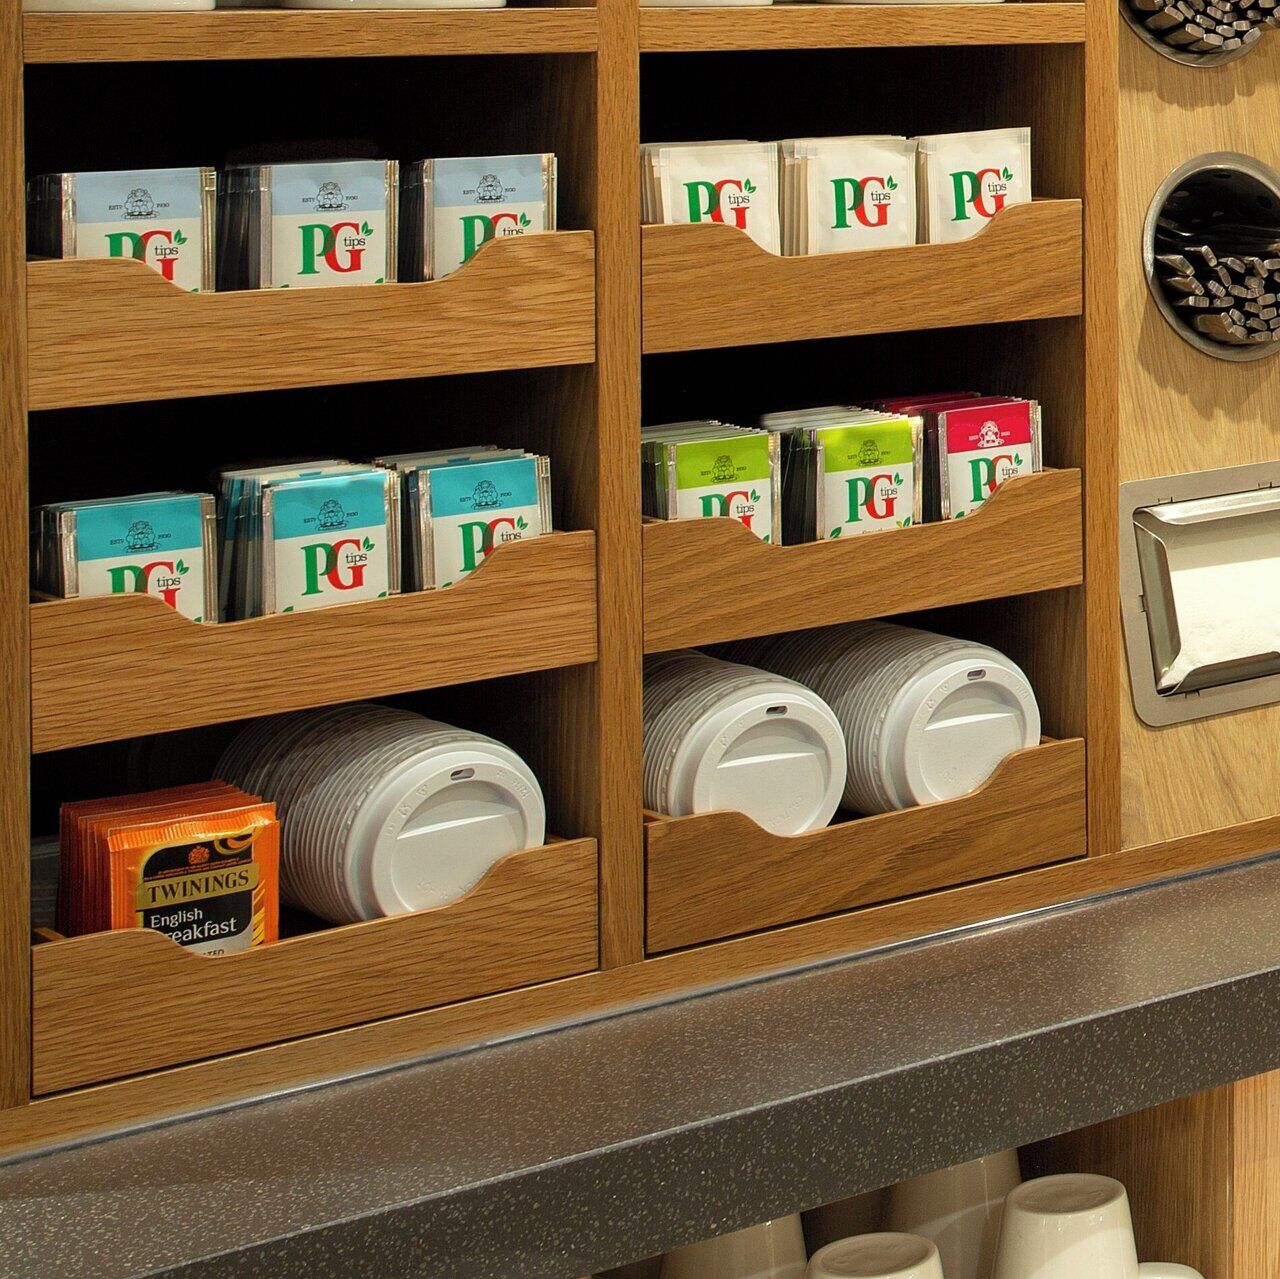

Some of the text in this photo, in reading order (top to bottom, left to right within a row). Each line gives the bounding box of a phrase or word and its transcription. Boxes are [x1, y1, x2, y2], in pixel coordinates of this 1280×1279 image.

[683, 179, 750, 230] PG tips
[830, 176, 891, 230] PG tips
[949, 168, 1008, 222] PG tips
[502, 226, 525, 235] tips
[154, 244, 179, 259] tips
[297, 221, 367, 275] PG tips
[1002, 467, 1019, 478] tips
[736, 504, 755, 516] tips
[845, 474, 898, 523] PG tips
[301, 539, 368, 596] PG tips
[157, 576, 181, 589] tips
[147, 870, 249, 903] TWININGS
[151, 908, 203, 928] English
[163, 918, 237, 942] reakfast
